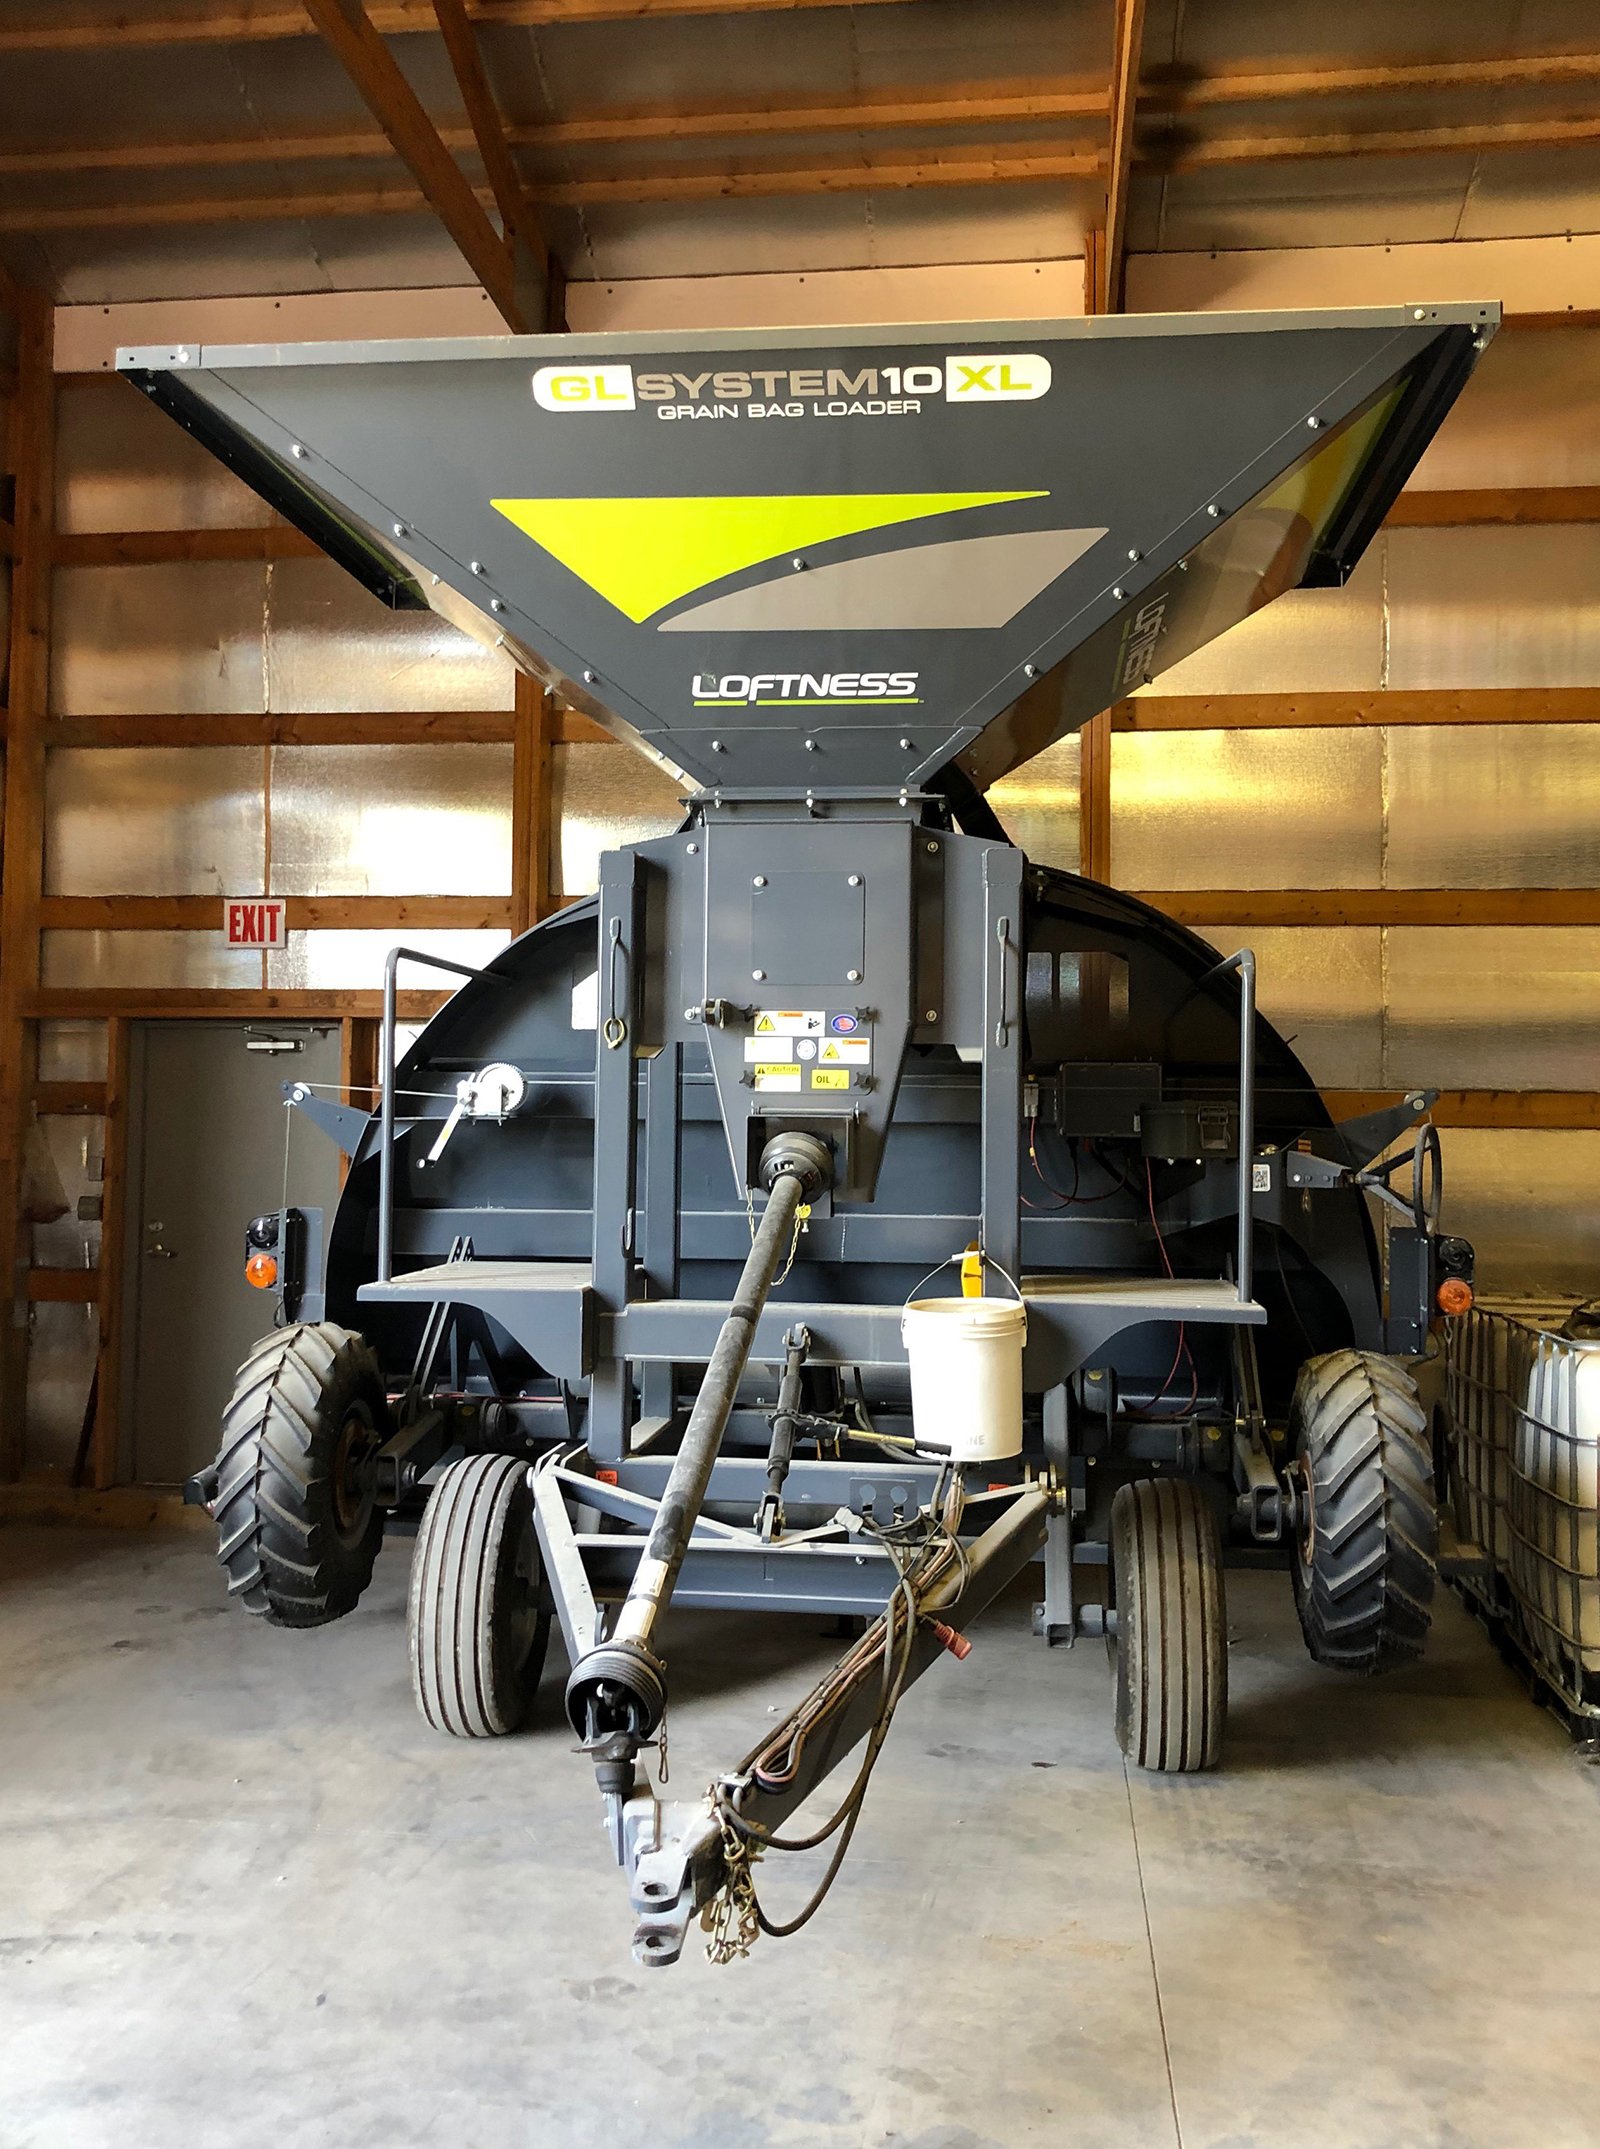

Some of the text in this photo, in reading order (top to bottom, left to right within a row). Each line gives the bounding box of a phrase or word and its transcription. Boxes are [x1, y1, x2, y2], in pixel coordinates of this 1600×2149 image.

[550, 374, 627, 401] GL
[956, 364, 1032, 391] XL
[657, 400, 921, 420] GRAIN BAG LOADER
[692, 672, 920, 701] LOFTNESS
[229, 905, 281, 942] EXIT
[816, 1076, 830, 1084] OIL
